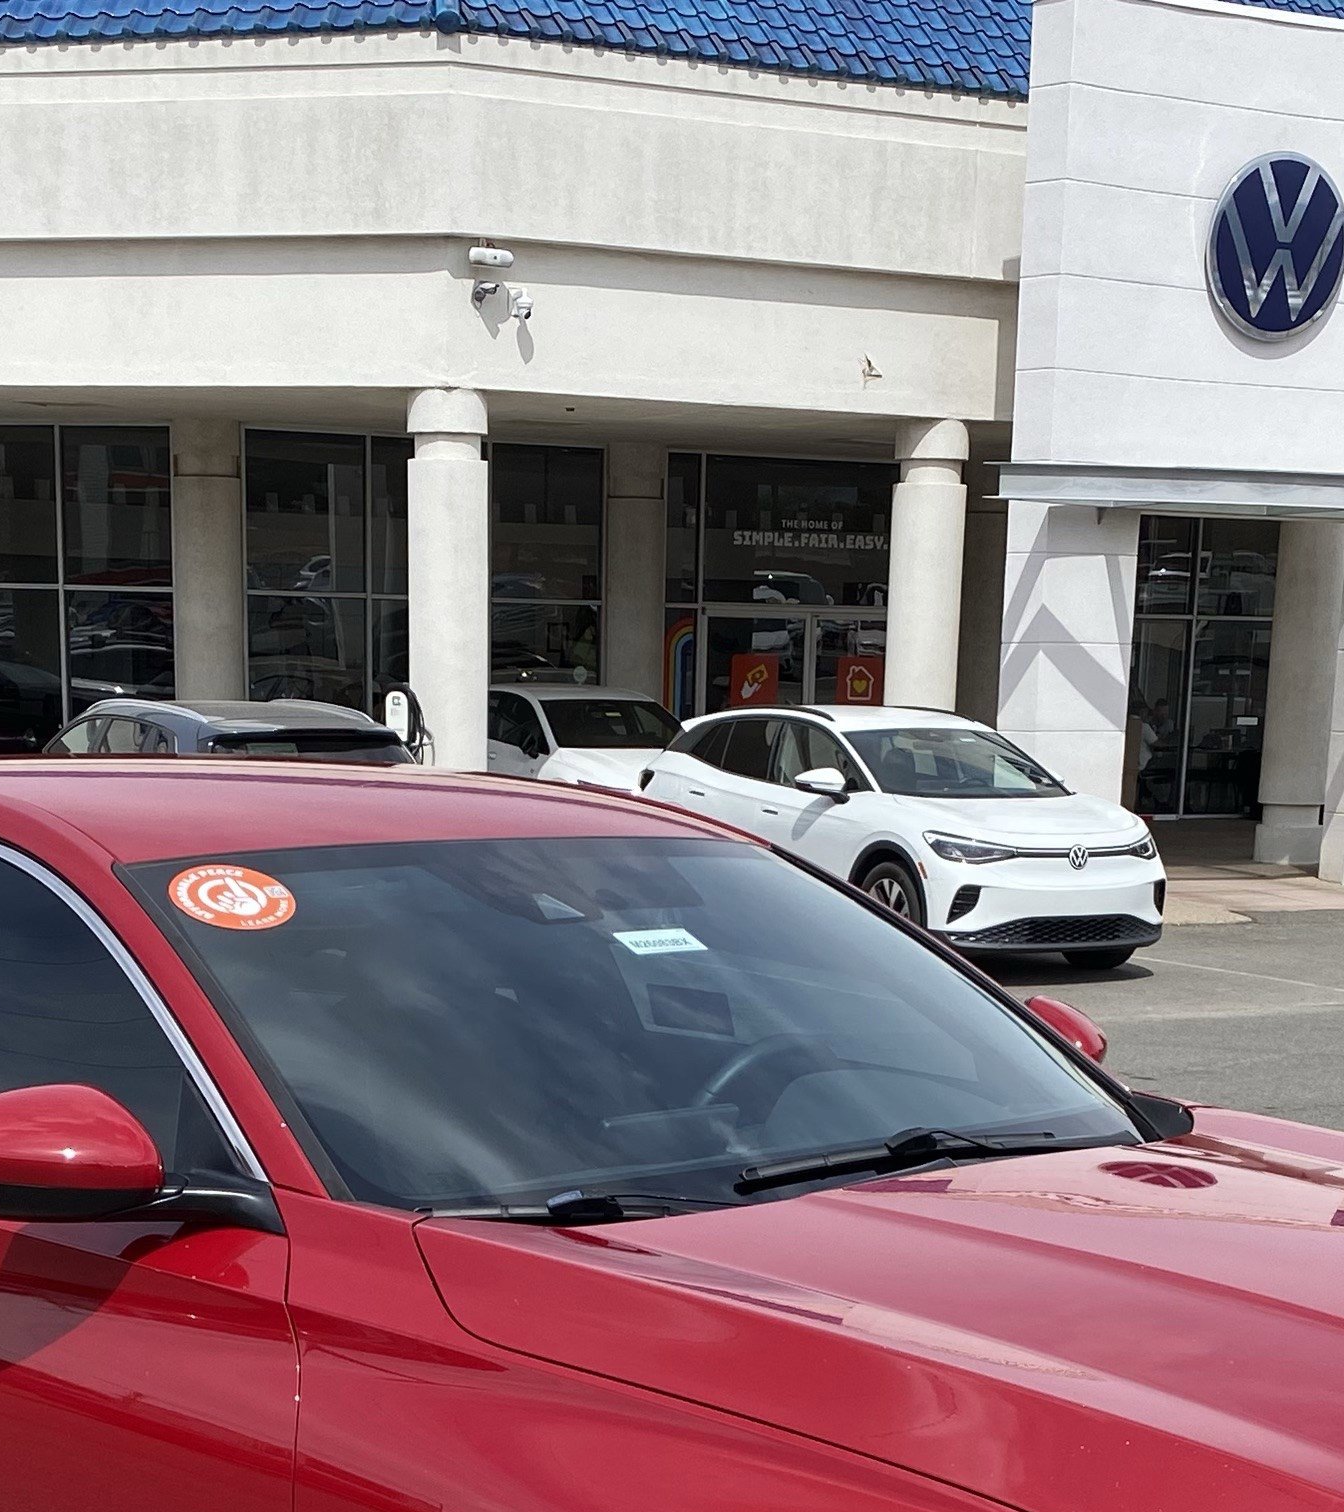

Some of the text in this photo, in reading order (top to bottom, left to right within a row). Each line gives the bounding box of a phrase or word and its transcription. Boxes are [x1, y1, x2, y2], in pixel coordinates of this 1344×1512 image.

[781, 519, 844, 530] THE HOME OF
[197, 868, 244, 878] PEACE
